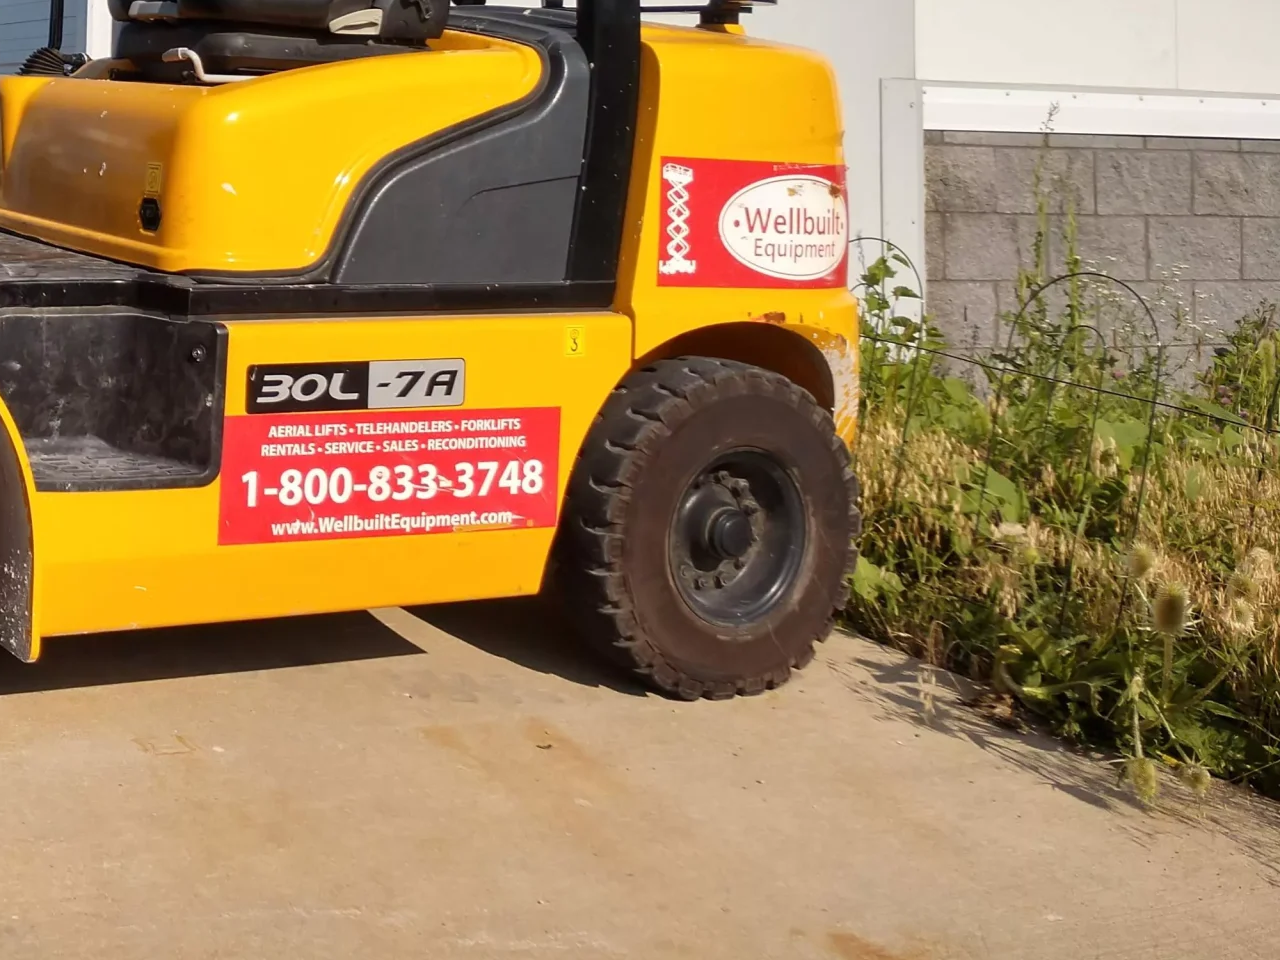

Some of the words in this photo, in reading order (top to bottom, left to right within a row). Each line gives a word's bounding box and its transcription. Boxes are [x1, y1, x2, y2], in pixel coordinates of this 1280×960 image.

[744, 207, 840, 235] Wellbuilt
[754, 238, 836, 263] Equipment
[268, 424, 312, 438] AERIAL
[314, 424, 347, 437] LIFTS
[355, 420, 453, 435] TELEHANDELERS
[461, 418, 521, 432] FORKLIFTS
[261, 443, 315, 457] RENTALS
[324, 441, 374, 454] SERVICE
[382, 439, 419, 453] SALES
[427, 436, 526, 451] RECONDITIONING
[241, 459, 544, 507] 1-800-833-3748
[271, 511, 513, 536] www.WellbuiltEquipment.com
